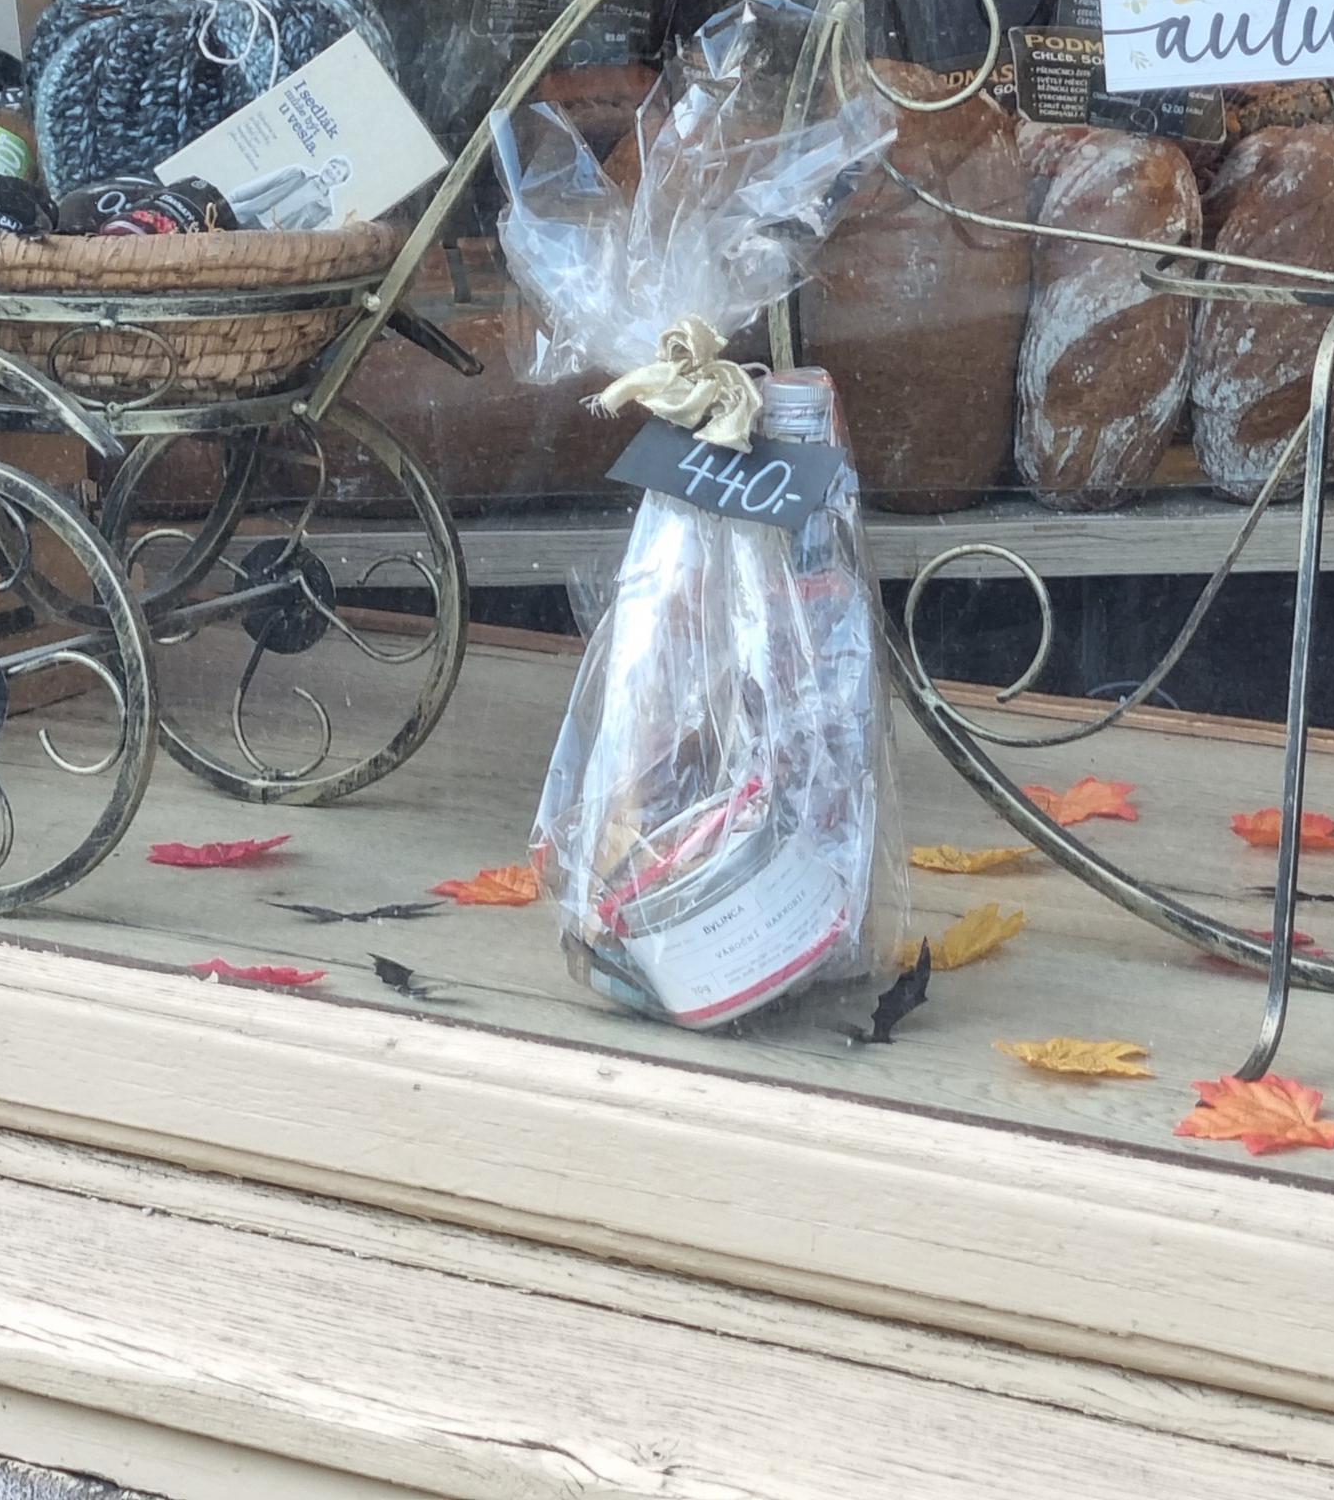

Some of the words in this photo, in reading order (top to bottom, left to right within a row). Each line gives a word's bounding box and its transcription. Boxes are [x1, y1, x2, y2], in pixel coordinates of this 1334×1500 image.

[278, 102, 291, 116] u
[287, 114, 316, 157] vesla.
[299, 89, 339, 140] sedlák
[678, 441, 803, 514] 440,-
